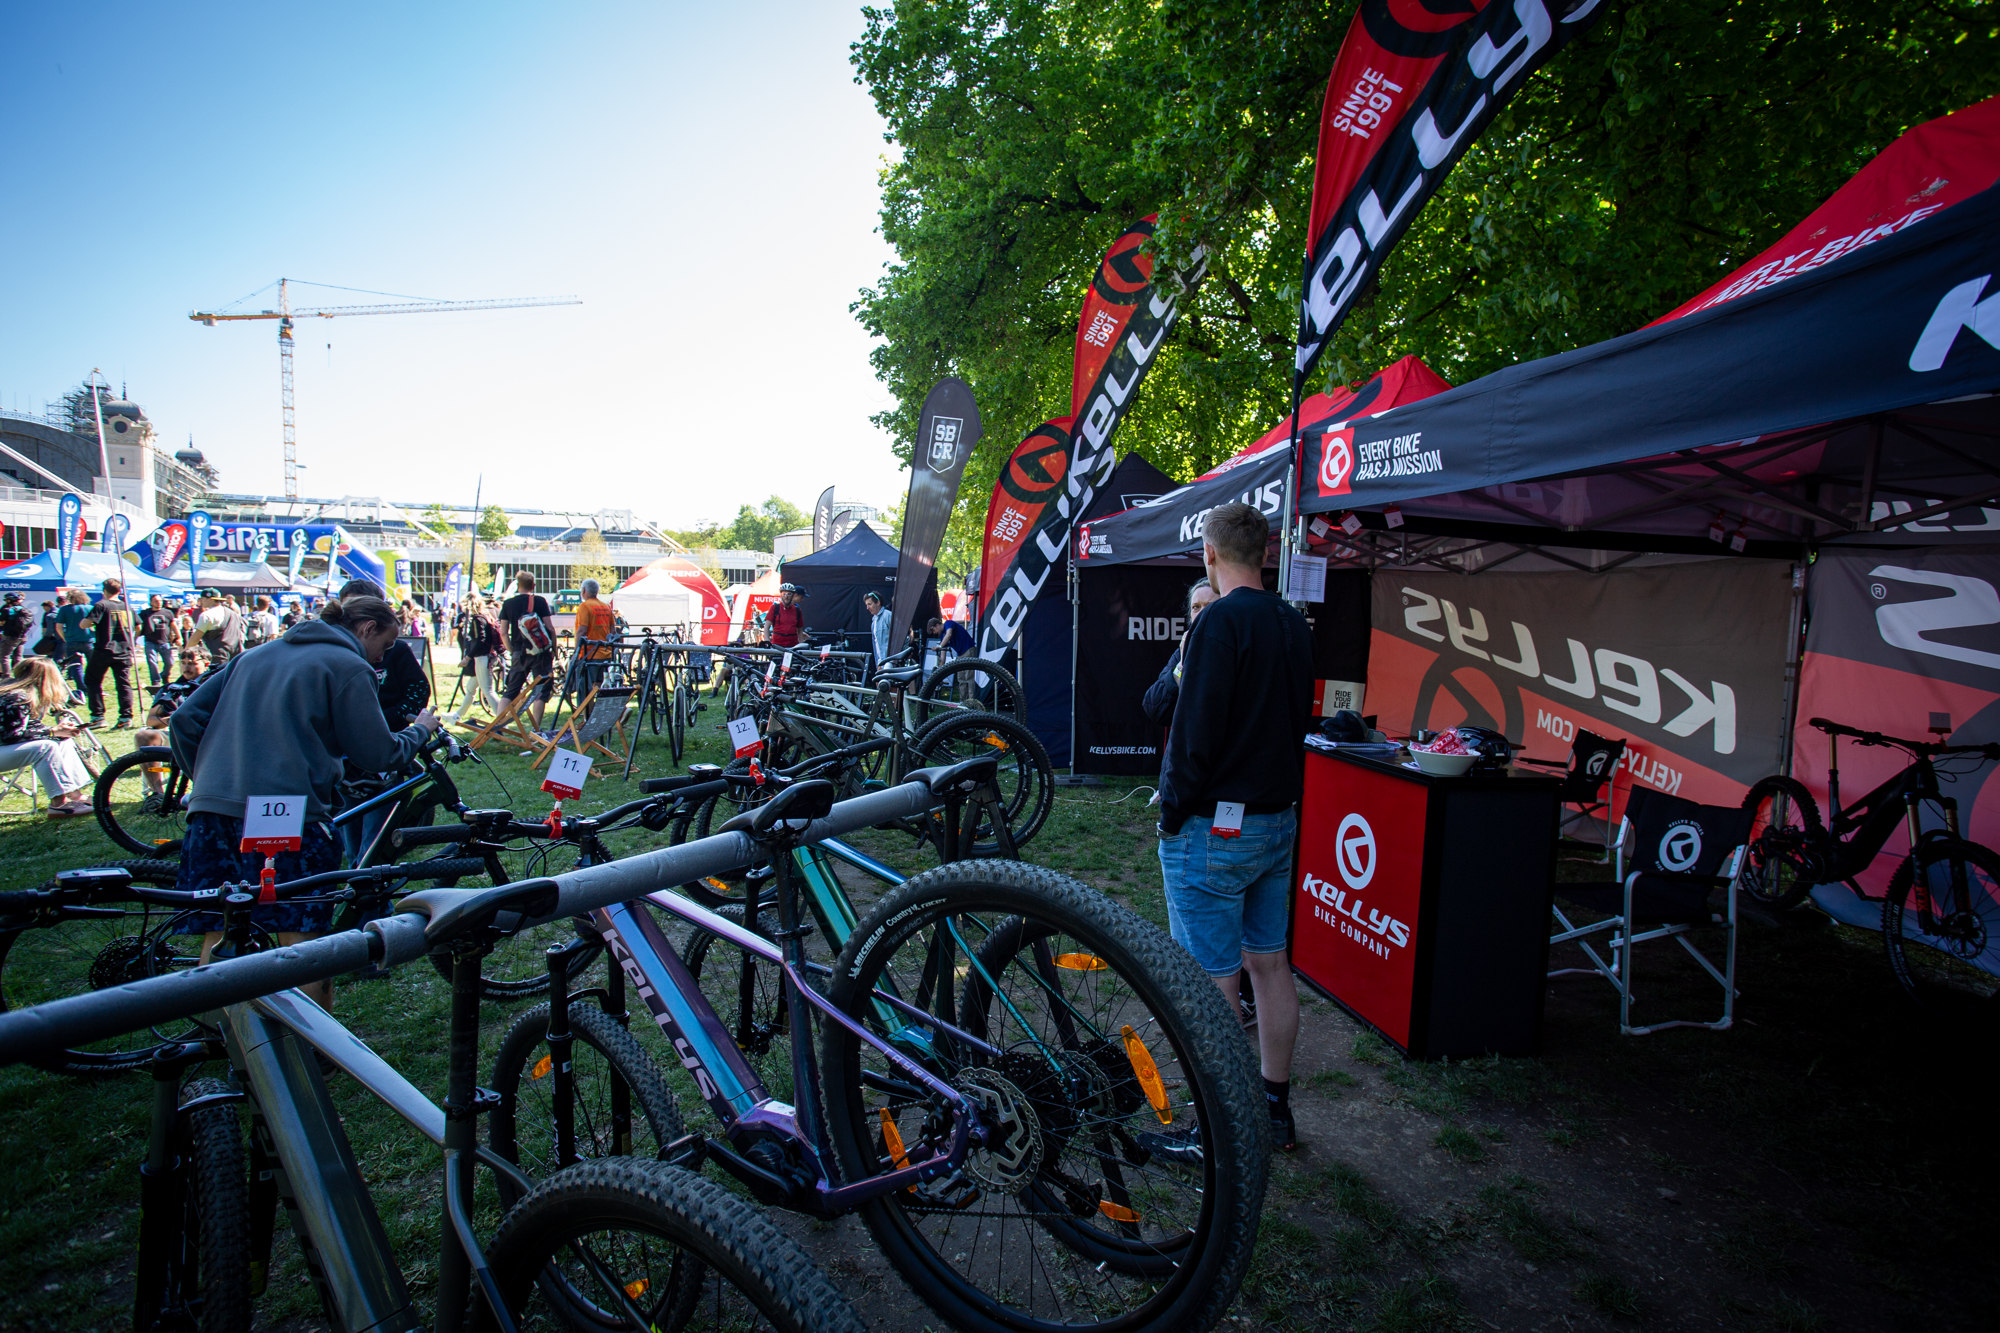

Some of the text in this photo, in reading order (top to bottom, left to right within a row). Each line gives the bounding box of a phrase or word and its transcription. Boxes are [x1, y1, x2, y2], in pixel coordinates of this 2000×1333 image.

[1333, 67, 1384, 132] SINCE
[1350, 78, 1403, 139] 1991
[1811, 202, 1944, 261] BIKE
[1084, 309, 1109, 343] SINCE
[1094, 315, 1119, 348] 1991
[935, 424, 956, 441] SB
[1358, 432, 1421, 463] EVERY BIKE
[932, 442, 953, 460] CR
[1356, 449, 1443, 481] HAS A MISSION
[992, 506, 1016, 539] SINCE
[1002, 512, 1028, 544] 1991
[1128, 616, 1186, 641] RIDE
[1334, 701, 1351, 709] LIFE
[1335, 690, 1352, 698] RIDE
[735, 722, 750, 734] 12.
[563, 757, 579, 773] 11.
[1089, 745, 1156, 755] KELLYSBIKE.COM
[261, 802, 290, 817] 10.
[1225, 806, 1234, 816] 7.
[853, 925, 886, 967] MICHELIN
[885, 906, 914, 927] Country
[1314, 905, 1390, 961] BIKE COMPANY
